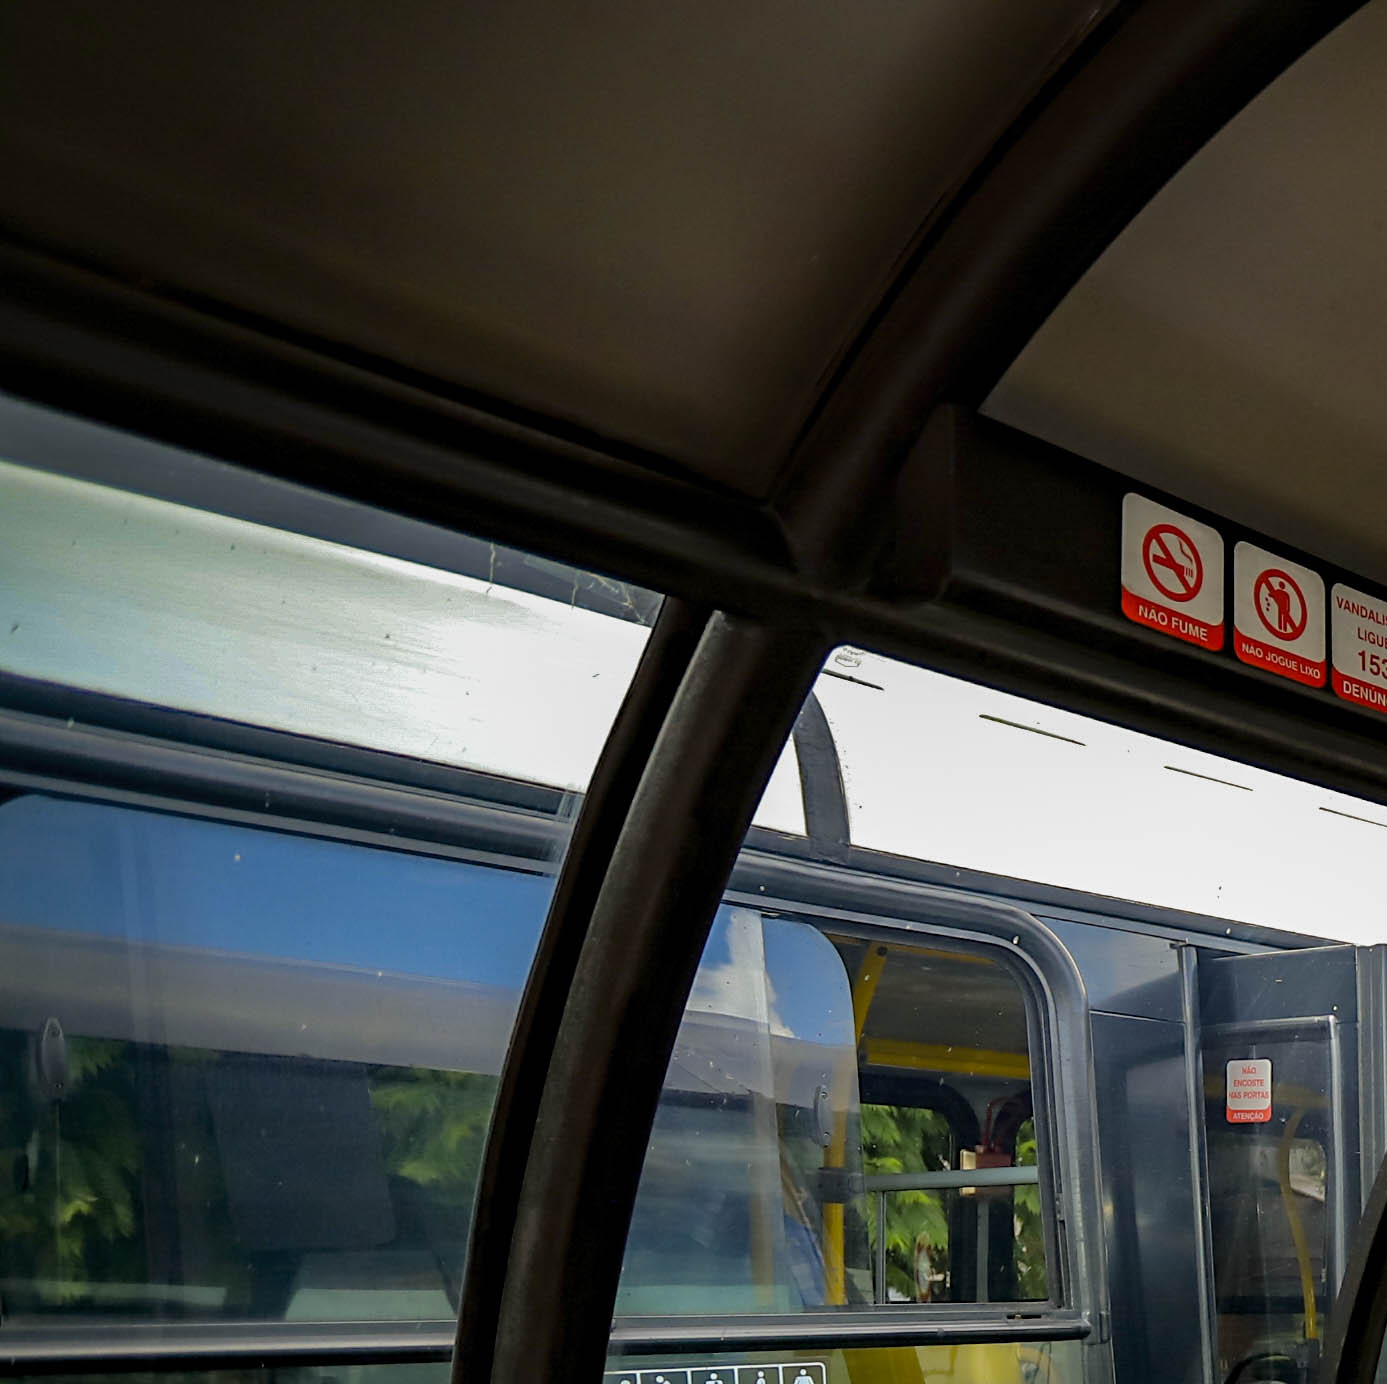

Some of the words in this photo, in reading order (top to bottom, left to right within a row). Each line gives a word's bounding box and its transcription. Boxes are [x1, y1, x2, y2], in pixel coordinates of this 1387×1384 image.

[1138, 604, 1167, 625] NÃO
[1171, 617, 1208, 642] FUME
[1241, 642, 1263, 659] NÃO
[1265, 650, 1298, 671] JOGUE
[1300, 662, 1320, 680] LIXO
[1233, 1079, 1264, 1087] ENCOSTE
[1243, 1091, 1269, 1099] PORTAS
[1233, 1112, 1264, 1121] ATENÇÃO
